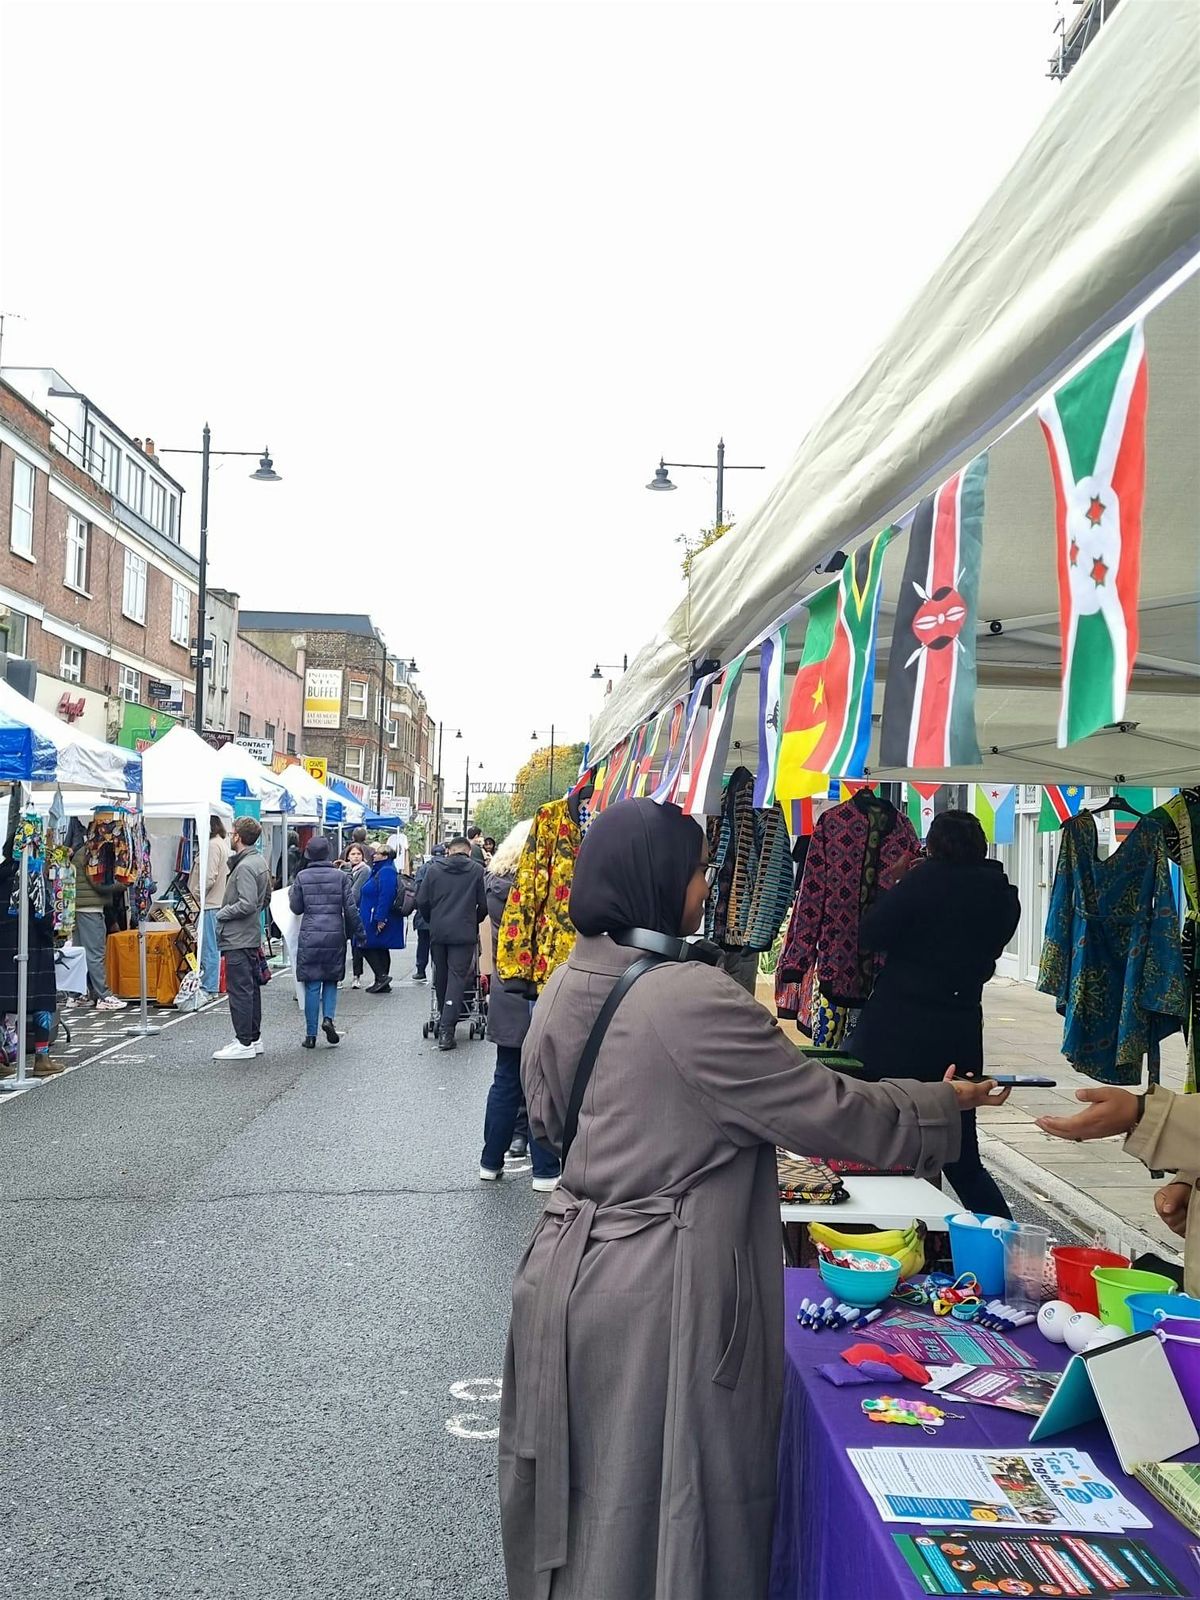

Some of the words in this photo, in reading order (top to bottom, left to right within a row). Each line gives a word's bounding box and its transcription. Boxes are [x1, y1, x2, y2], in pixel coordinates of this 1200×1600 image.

[307, 686, 338, 698] BUFFET
[236, 740, 271, 749] CONTACT
[1046, 1457, 1066, 1475] Get
[1030, 1457, 1066, 1498] Together
